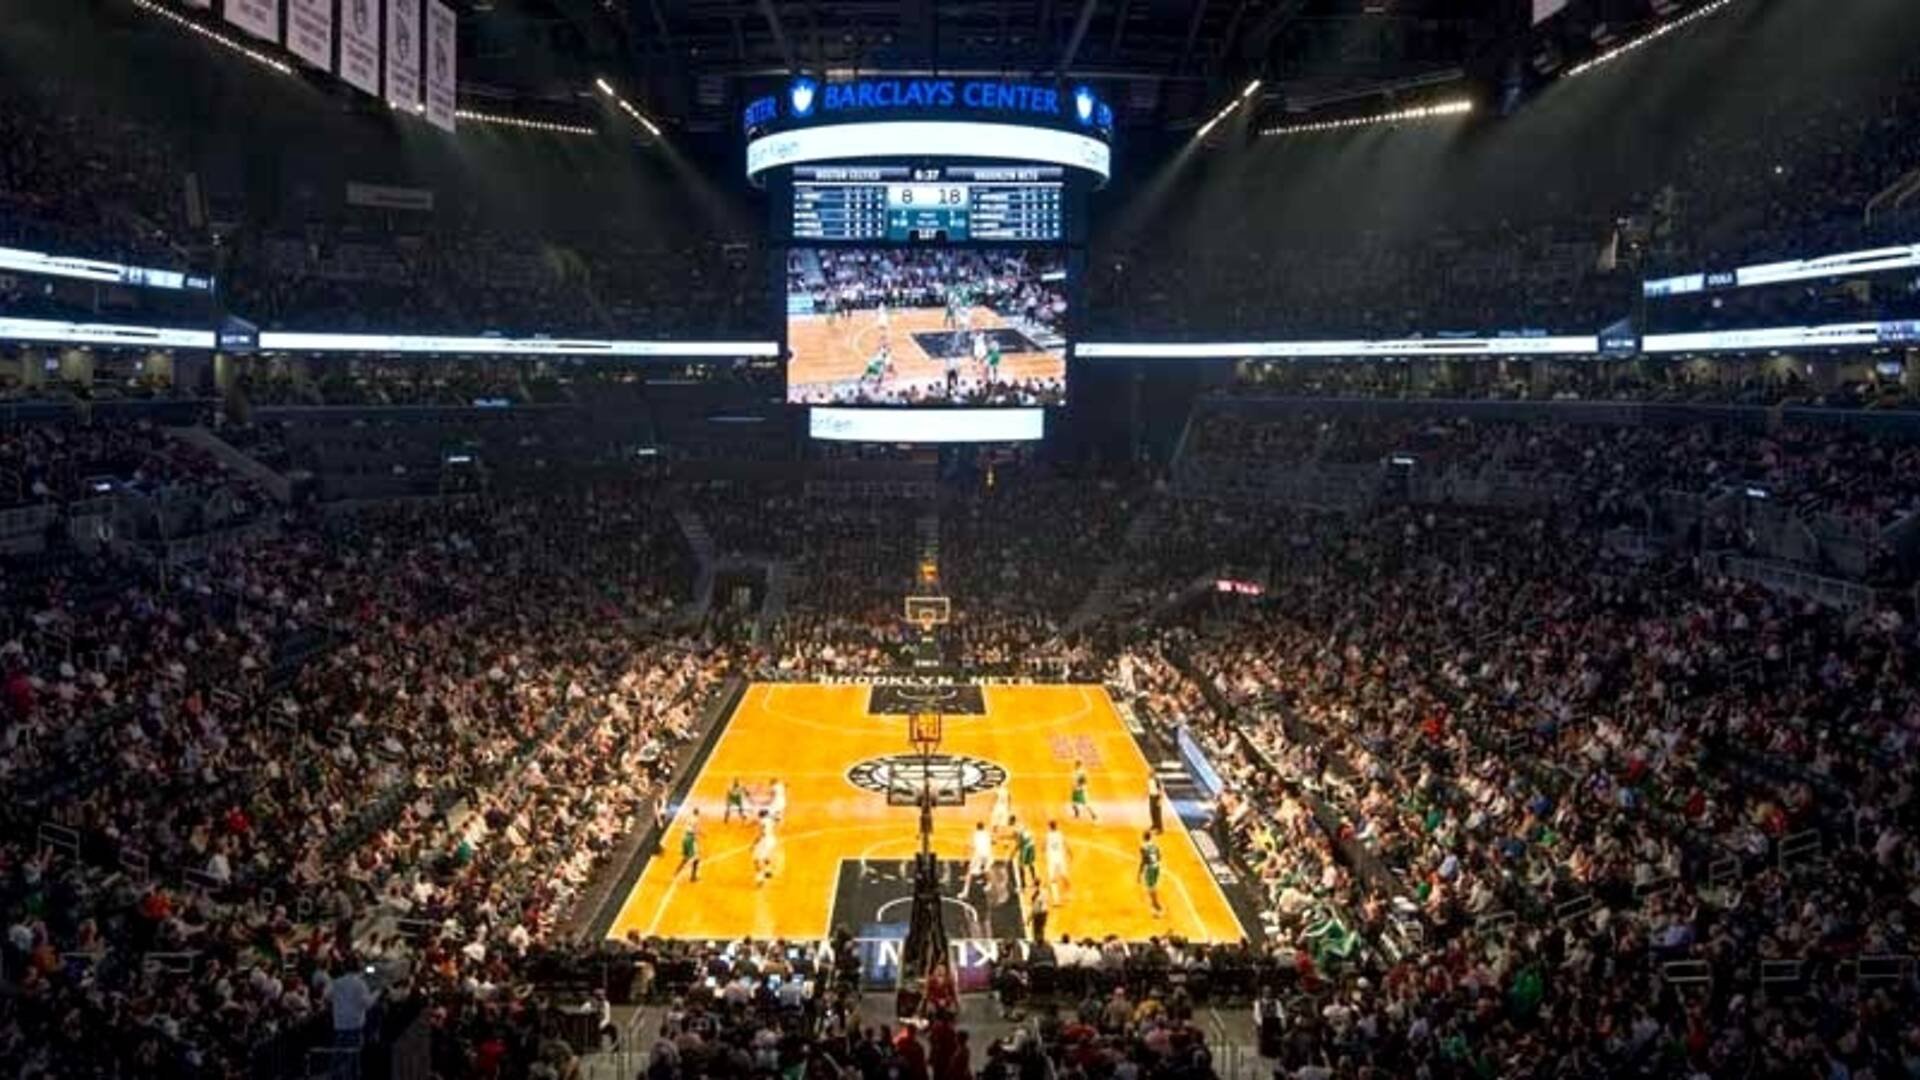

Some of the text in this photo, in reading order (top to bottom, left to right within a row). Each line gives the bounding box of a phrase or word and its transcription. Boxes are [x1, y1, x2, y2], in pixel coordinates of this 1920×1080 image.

[824, 80, 1060, 113] BARCLAYS CENTER
[901, 188, 914, 204] 8
[938, 188, 961, 204] 18
[818, 675, 1035, 686] BROOKLYN NETS
